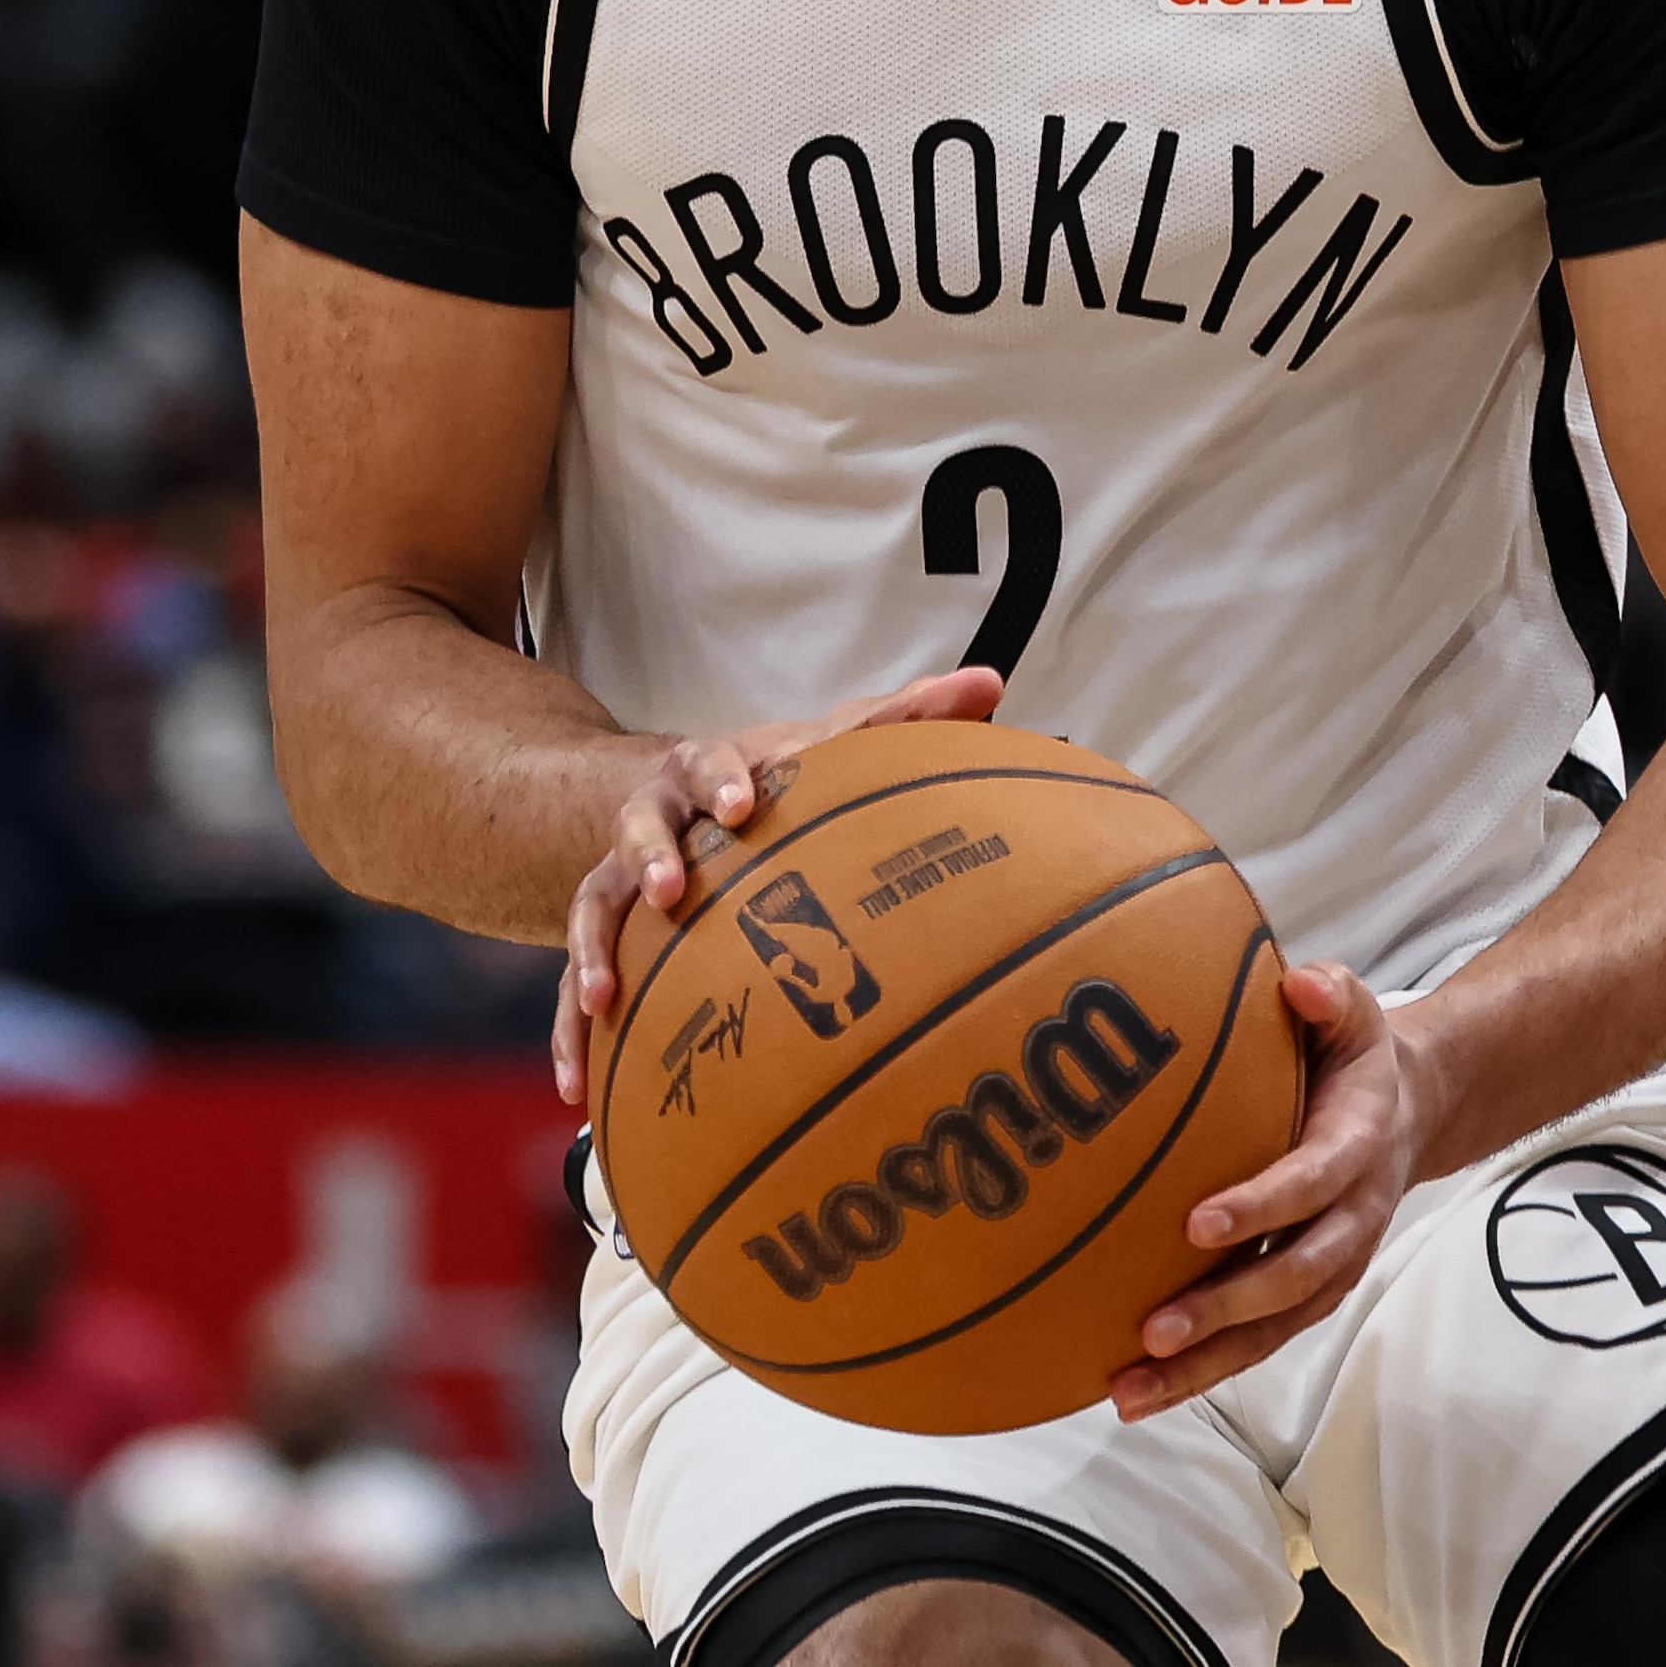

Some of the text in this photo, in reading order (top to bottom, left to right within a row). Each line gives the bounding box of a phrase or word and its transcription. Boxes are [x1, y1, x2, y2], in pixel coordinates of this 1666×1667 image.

[602, 114, 1414, 378] BROOKLYN
[921, 444, 1064, 726] 2
[741, 979, 1181, 1302] Wilson
